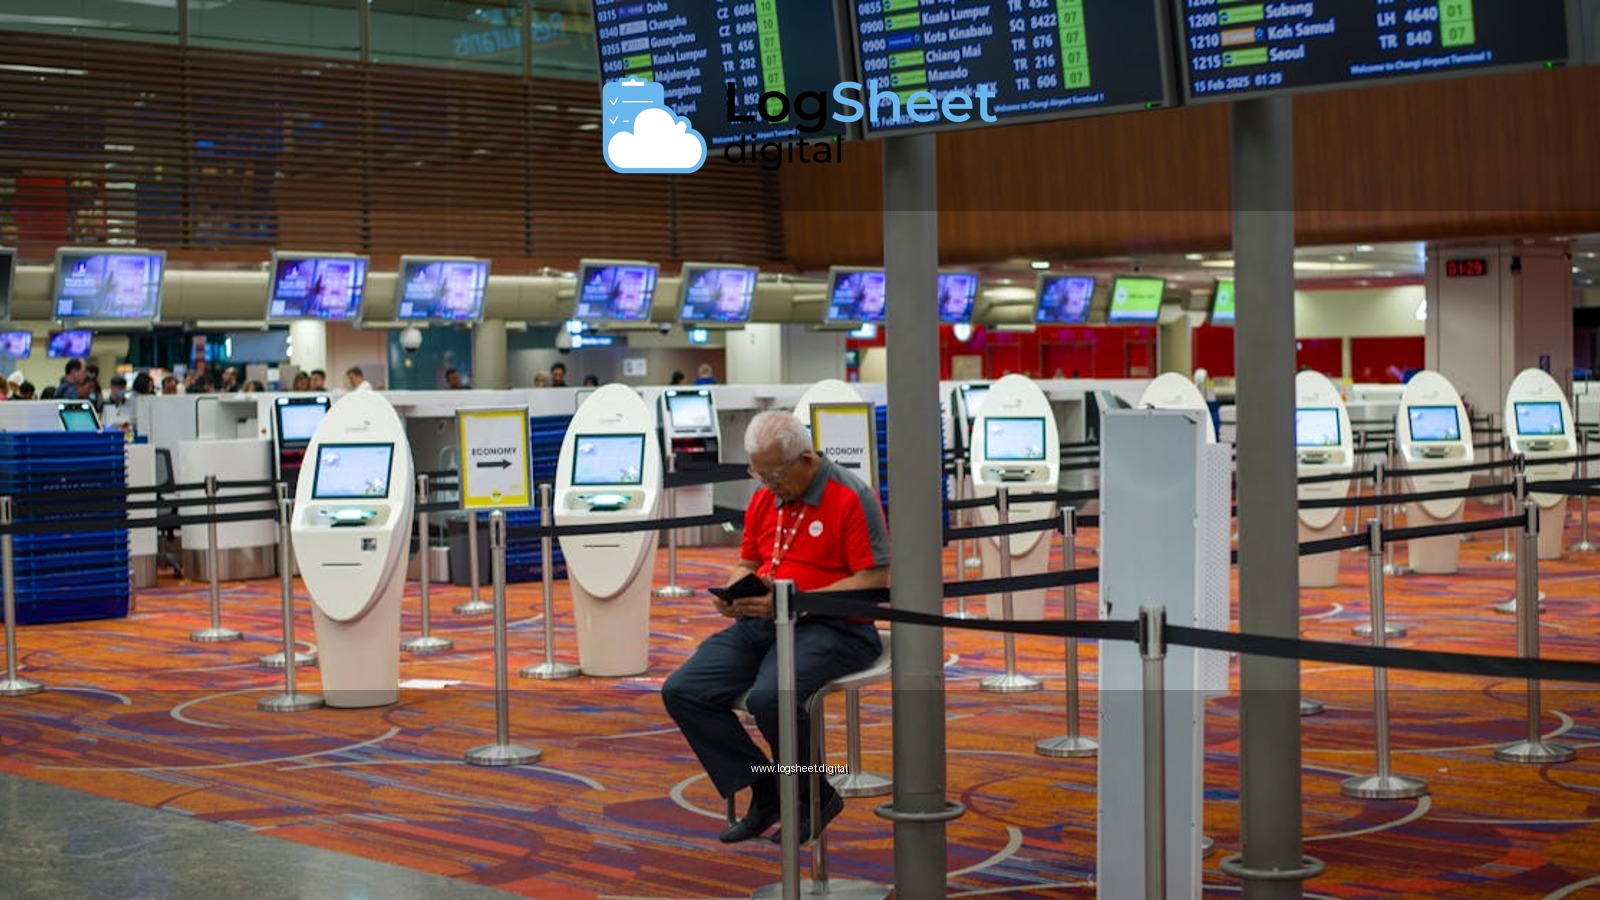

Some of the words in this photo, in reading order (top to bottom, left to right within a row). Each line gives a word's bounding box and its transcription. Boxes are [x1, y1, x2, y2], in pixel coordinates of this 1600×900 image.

[600, 26, 619, 39] 0340
[649, 16, 687, 31] Changsha
[717, 7, 729, 20] CZ
[761, 1, 771, 12] 10
[647, 2, 668, 14] Doha
[858, 2, 881, 16] 0855
[860, 20, 884, 34] 0900
[921, 10, 950, 25] Kuala
[951, 5, 990, 20] Lumpur
[1007, 0, 1022, 12] TR
[1188, 12, 1217, 28] 1200
[1265, 2, 1313, 19] Subang
[602, 44, 620, 56] 0355
[650, 32, 696, 48] Guangzhou
[719, 25, 731, 37] CZ
[862, 38, 886, 53] 0900
[923, 31, 947, 44] Kota
[949, 22, 993, 40] Kinabalu
[1009, 18, 1025, 32] SQ
[1030, 13, 1058, 29] 8422
[1064, 11, 1077, 23] 07
[1190, 33, 1220, 49] 1210
[1267, 24, 1293, 40] Koh
[1295, 18, 1335, 37] Samui
[1376, 11, 1396, 28] LH
[1404, 6, 1438, 24] 4640
[1447, 4, 1463, 17] 01
[603, 60, 622, 73] 0450
[653, 52, 675, 65] Kuala
[676, 48, 707, 62] Lumpur
[721, 43, 733, 55] TR
[738, 39, 754, 52] 456
[723, 61, 735, 72] TR
[740, 57, 756, 70] 292
[766, 54, 777, 65] 07
[864, 57, 888, 72] 0900
[926, 49, 961, 63] Chiang
[962, 43, 981, 58] Mai
[1011, 38, 1026, 52] TR
[1032, 34, 1053, 49] 676
[1066, 31, 1078, 44] 07
[1192, 54, 1221, 71] 1215
[1269, 44, 1305, 62] Seoul
[1378, 34, 1398, 50] TR
[1405, 29, 1433, 47] 840
[1449, 26, 1465, 41] 07
[866, 76, 889, 90] 020
[928, 66, 968, 82] Manado
[1013, 58, 1028, 71] TR
[1034, 53, 1055, 69] 216
[1068, 51, 1080, 64] 07
[1015, 77, 1030, 91] TR
[1036, 74, 1057, 89] 606
[1070, 72, 1083, 84] 07
[1194, 81, 1206, 92] 15
[1207, 78, 1225, 91] Feb
[1226, 76, 1250, 89] 2025
[1254, 72, 1283, 87] 01:29
[663, 84, 702, 99] uangzhou
[742, 74, 758, 88] 100
[768, 72, 778, 83] 07
[471, 447, 517, 456] ECONOMY
[825, 447, 864, 456] ECONOMY
